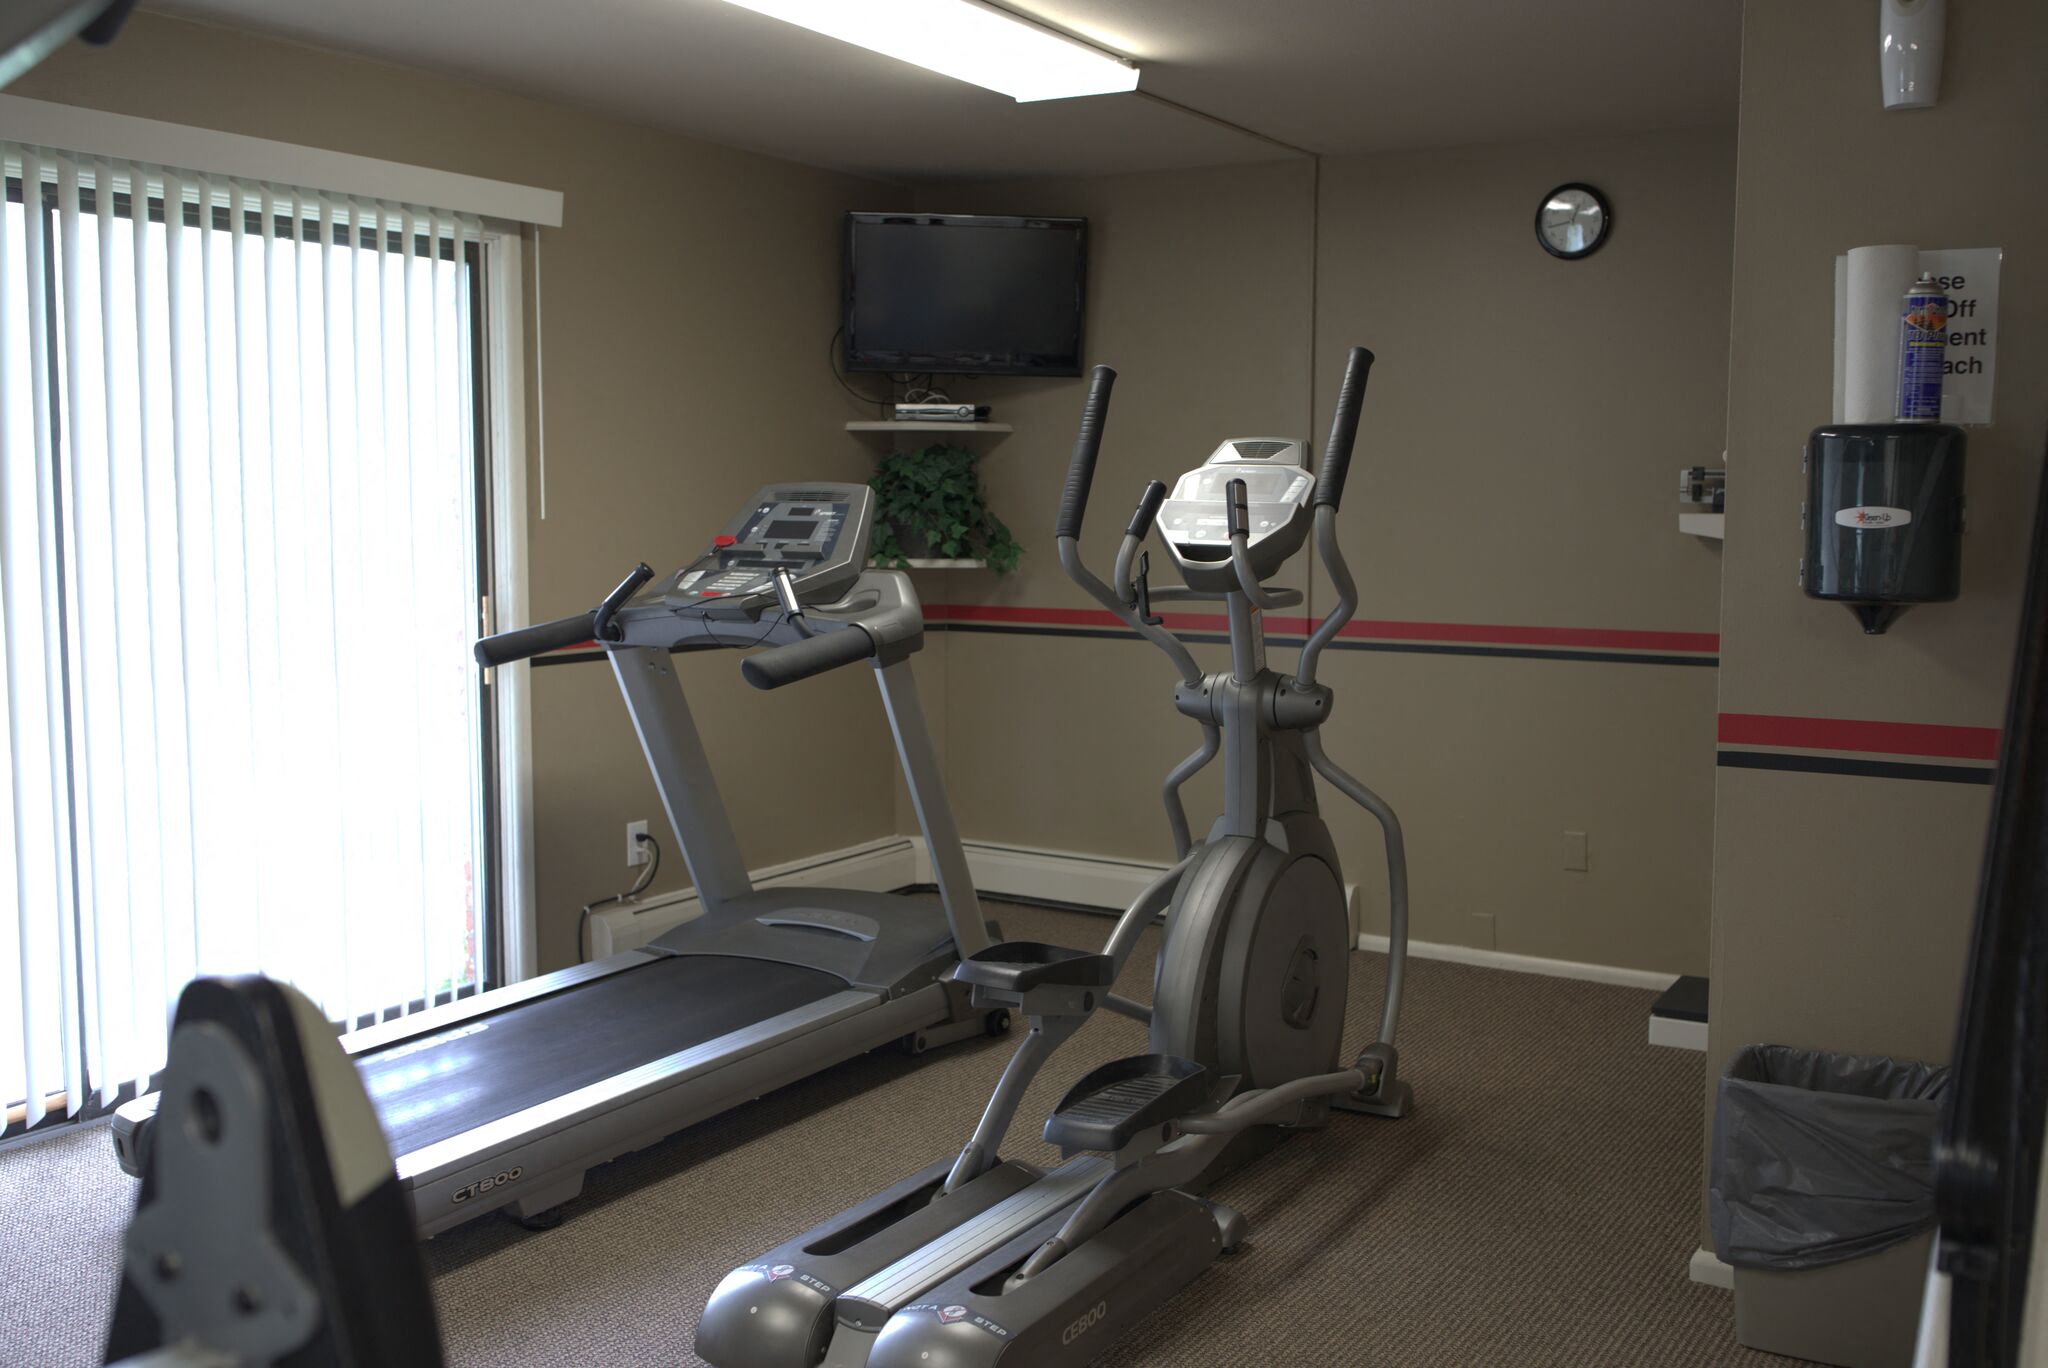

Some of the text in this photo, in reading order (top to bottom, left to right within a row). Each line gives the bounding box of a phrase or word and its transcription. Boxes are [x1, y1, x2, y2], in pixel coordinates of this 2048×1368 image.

[1931, 275, 1965, 290] se
[1949, 328, 1986, 346] ent
[1943, 356, 1982, 375] ach
[451, 1166, 523, 1203] CT800
[799, 1274, 831, 1292] STEP
[974, 1316, 1007, 1336] STEP
[1062, 1300, 1106, 1345] CE800
